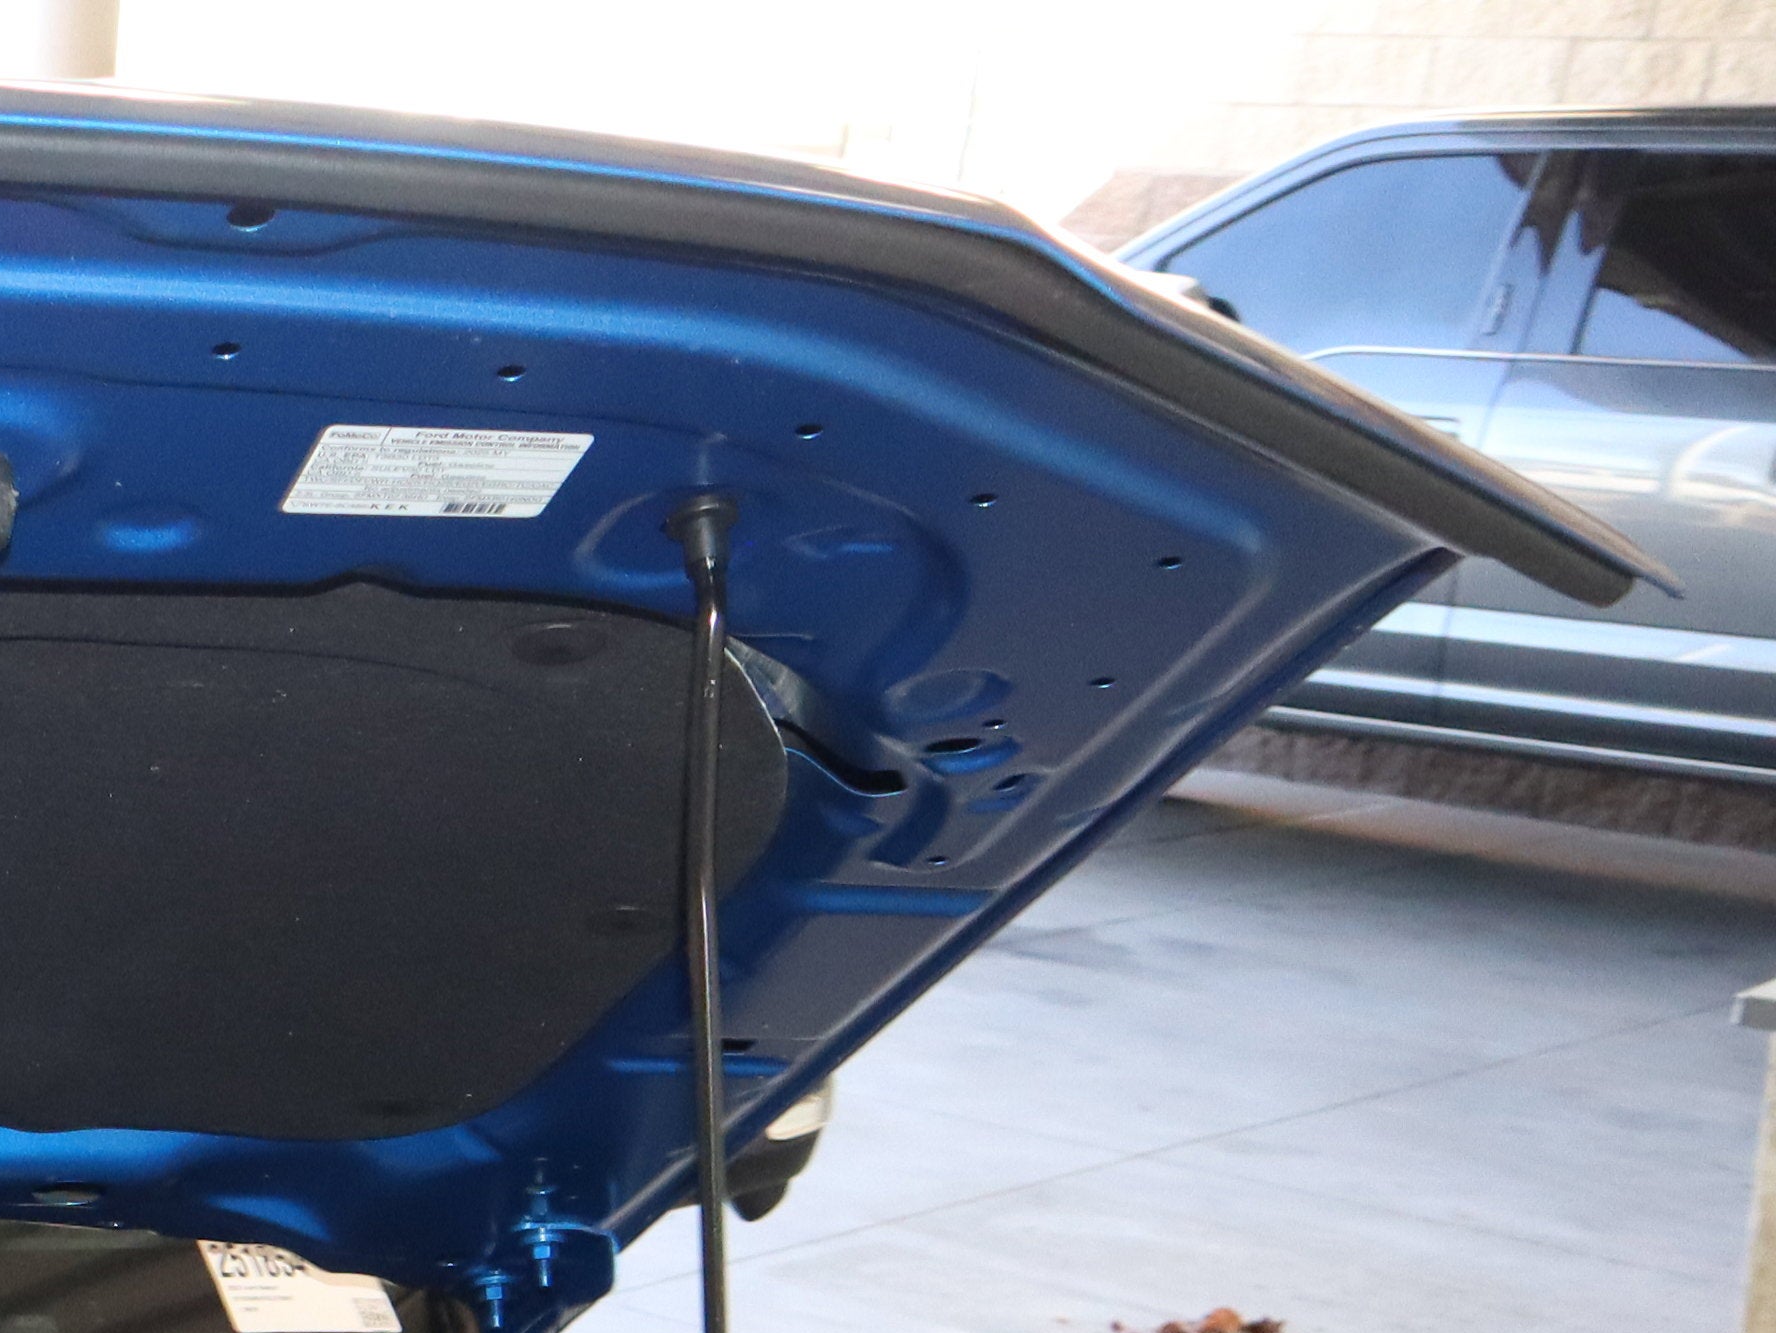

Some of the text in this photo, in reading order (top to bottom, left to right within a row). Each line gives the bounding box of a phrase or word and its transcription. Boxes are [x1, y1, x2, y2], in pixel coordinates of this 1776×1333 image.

[414, 431, 565, 444] Ford Motor Company
